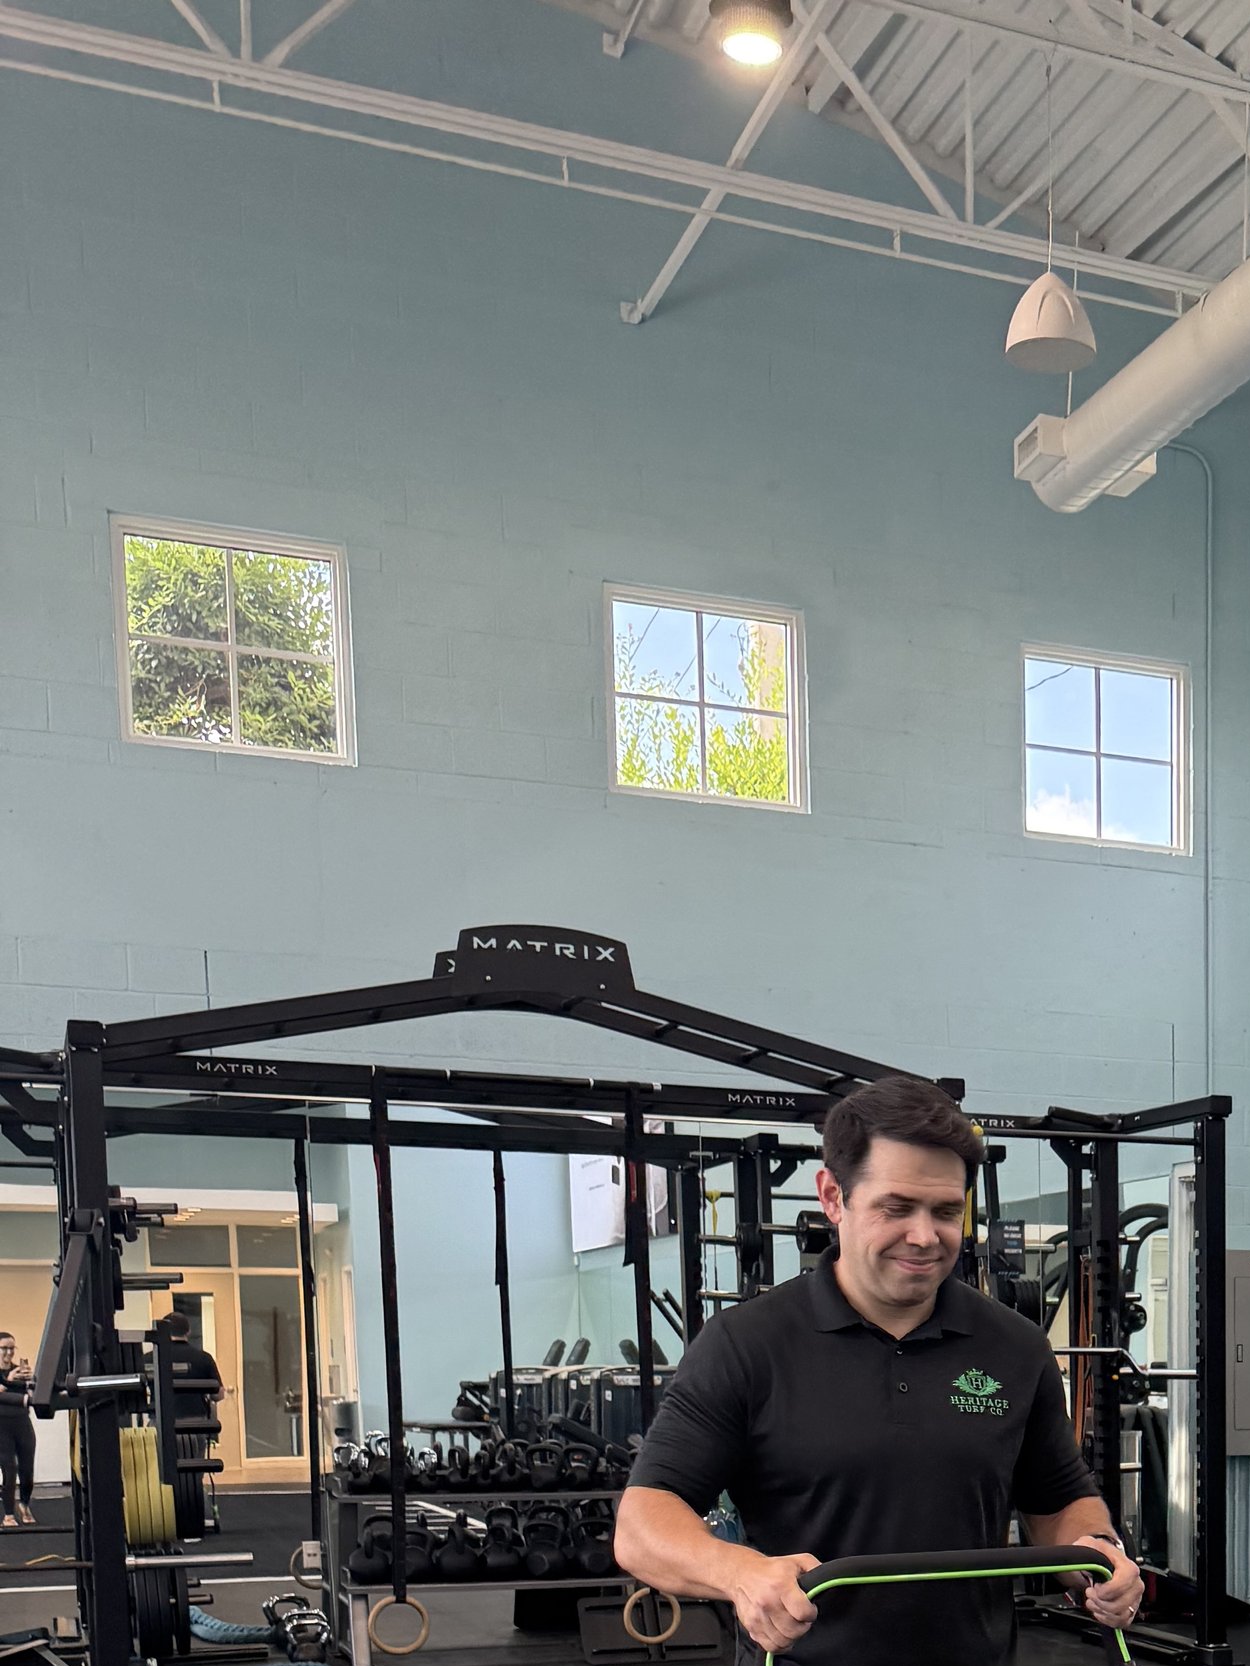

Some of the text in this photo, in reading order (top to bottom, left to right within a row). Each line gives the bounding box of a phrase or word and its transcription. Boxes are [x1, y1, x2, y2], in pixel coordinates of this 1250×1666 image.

[472, 936, 615, 962] MATRIX
[196, 1061, 278, 1075] MATRIX
[727, 1093, 796, 1107] MATRIX
[970, 1118, 1015, 1128] ATRIX
[950, 1395, 1009, 1409] HERITAGE
[958, 1404, 985, 1413] TURF
